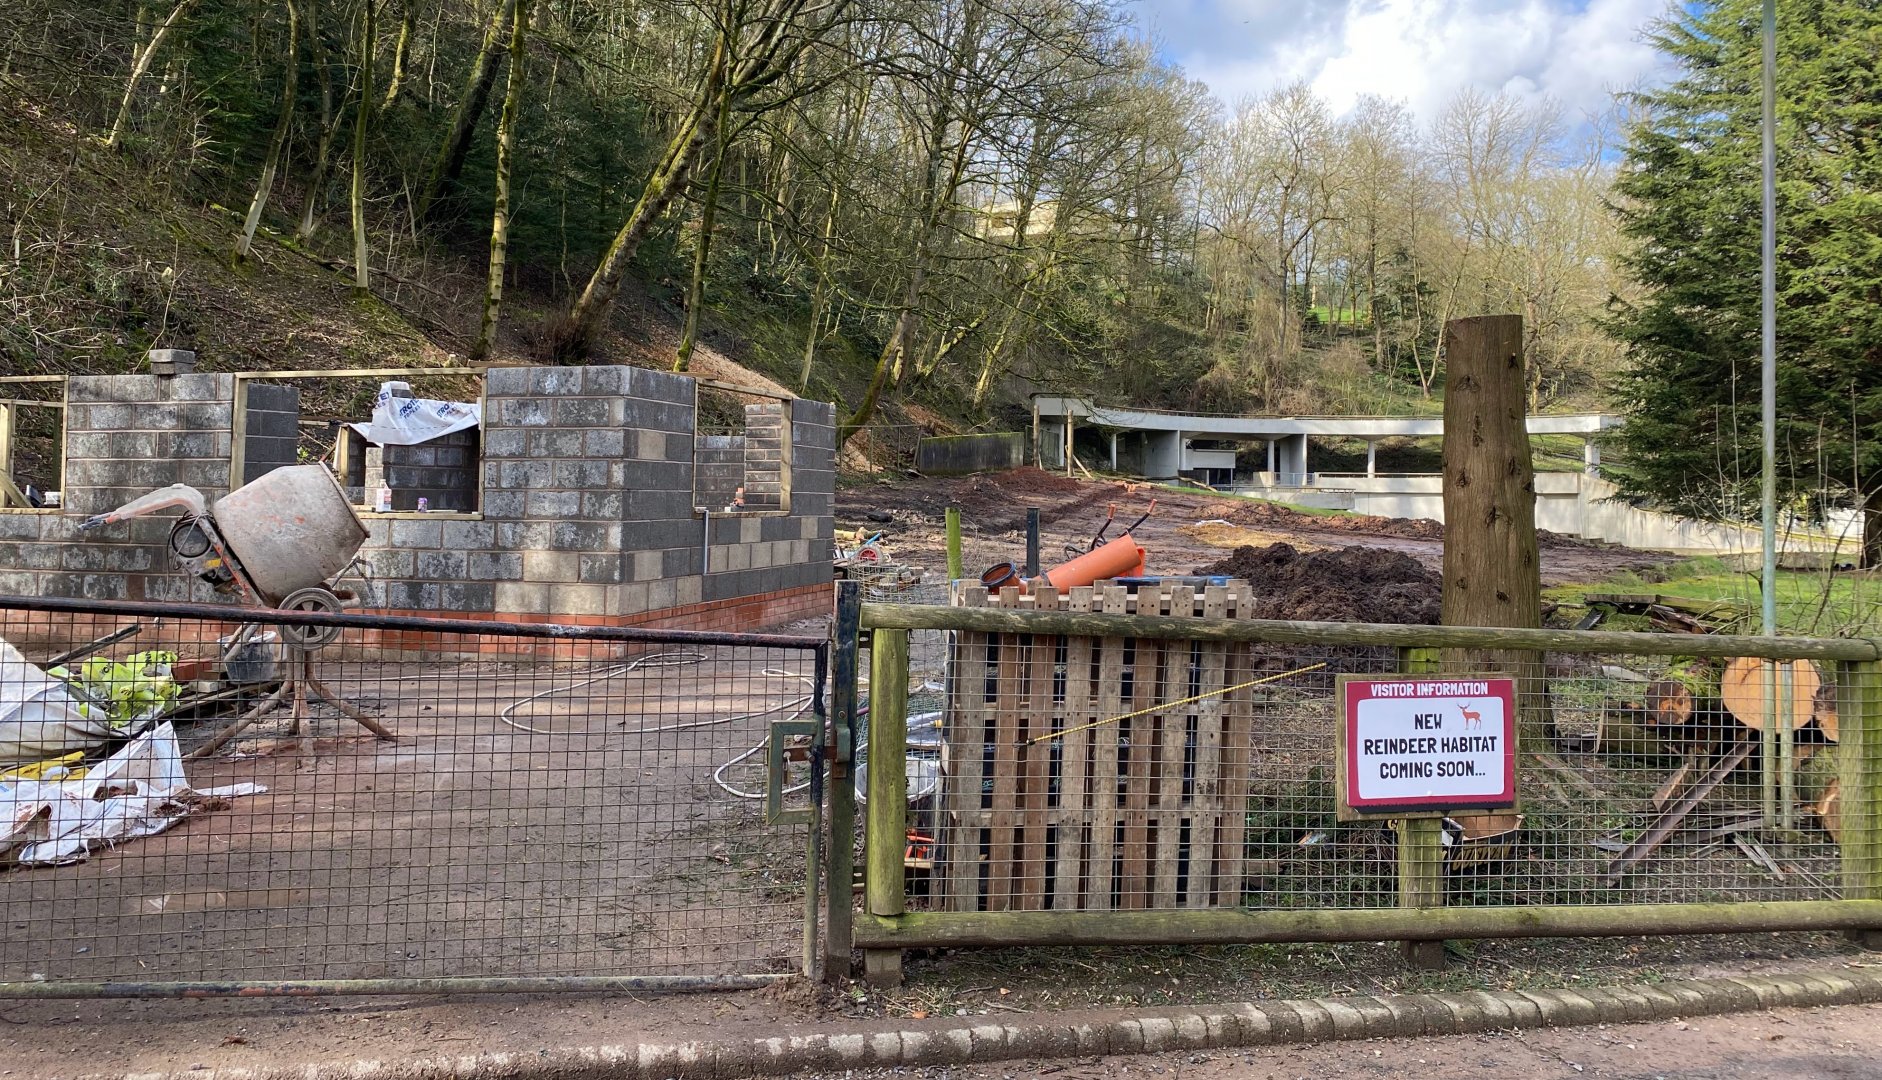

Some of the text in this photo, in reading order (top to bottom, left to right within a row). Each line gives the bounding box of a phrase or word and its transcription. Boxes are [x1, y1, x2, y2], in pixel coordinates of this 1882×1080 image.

[1371, 682, 1488, 697] VISITOR INFORMATION
[1414, 713, 1442, 730] NEW
[1364, 736, 1497, 755] REINDEER HABITAT
[1379, 760, 1486, 779] COMING SOON...
